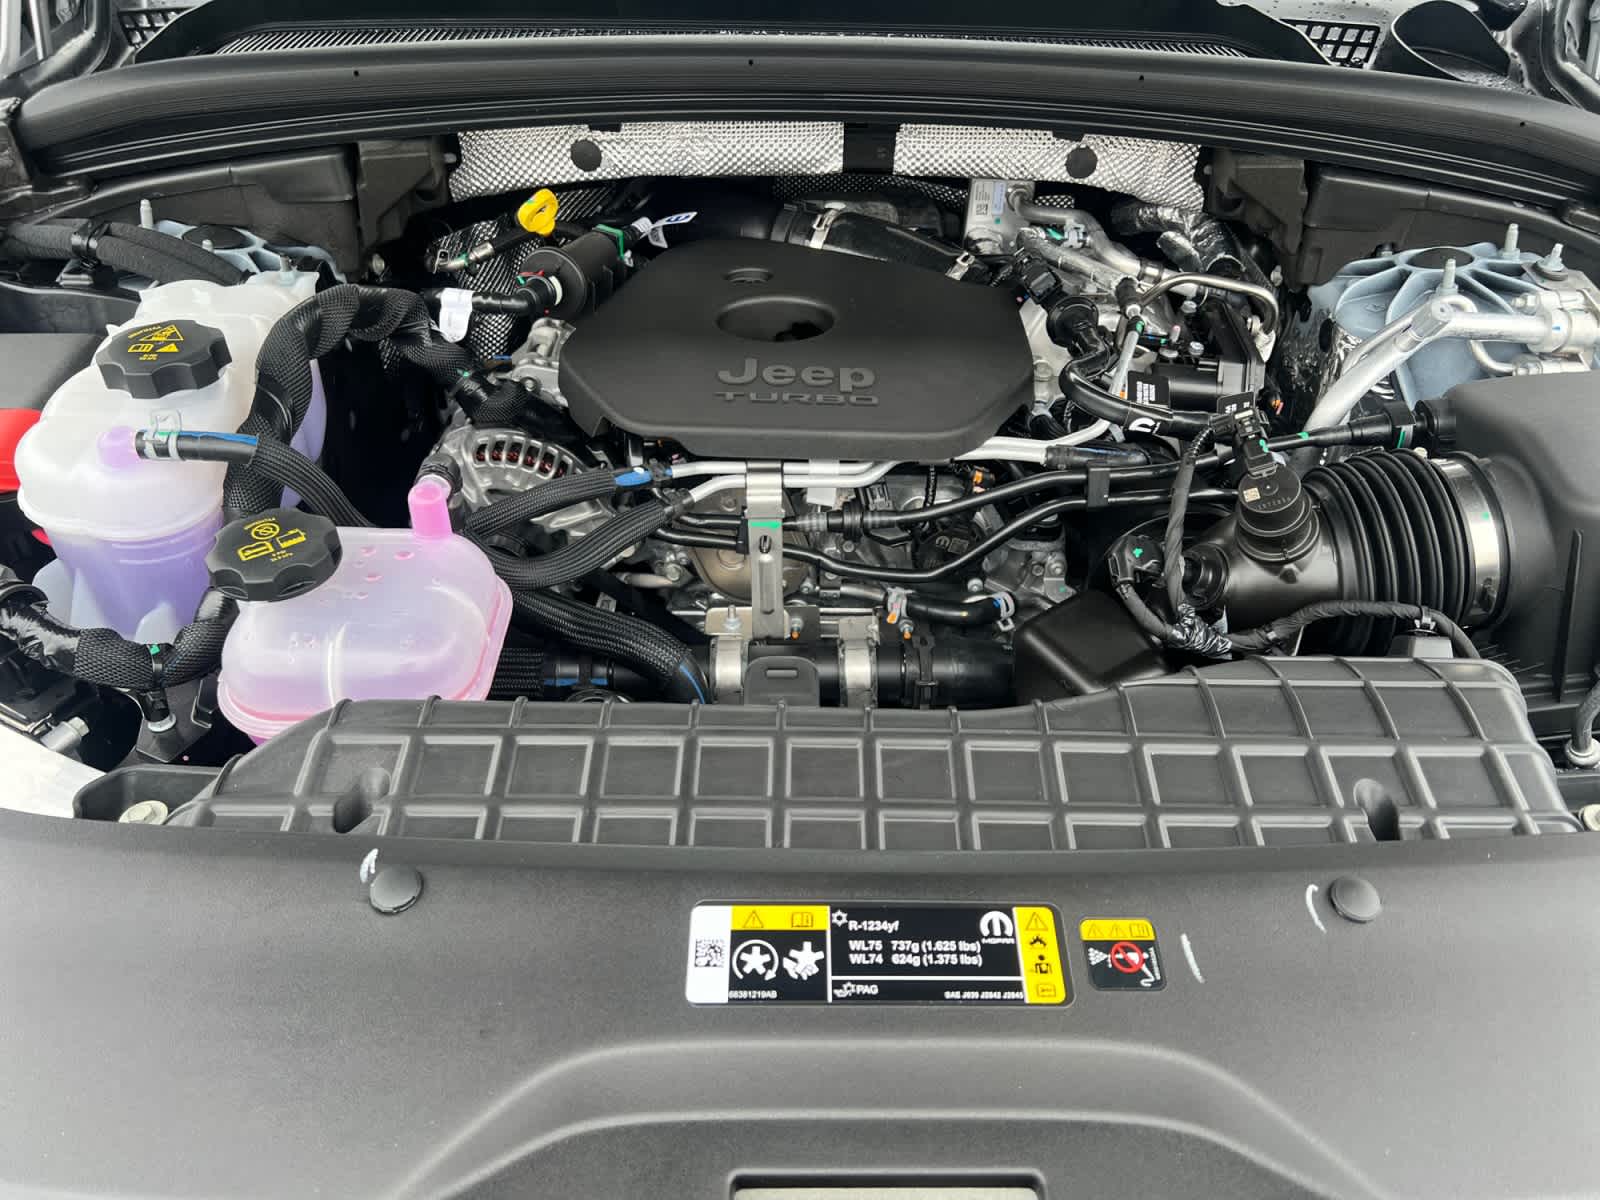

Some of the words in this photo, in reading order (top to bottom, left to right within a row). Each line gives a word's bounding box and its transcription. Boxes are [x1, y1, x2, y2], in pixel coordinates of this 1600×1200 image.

[717, 357, 876, 393] Jeep
[714, 391, 880, 406] TURBO
[848, 920, 899, 933] R-1234yf
[848, 940, 883, 951] WL75
[891, 940, 919, 953] 737g
[921, 940, 957, 953] (1.625
[958, 940, 981, 953] lbs)
[848, 953, 884, 965] WL74
[891, 953, 920, 967] 624g
[922, 953, 958, 967] (1.375
[959, 953, 983, 967] lbs)
[856, 984, 879, 996] PAG
